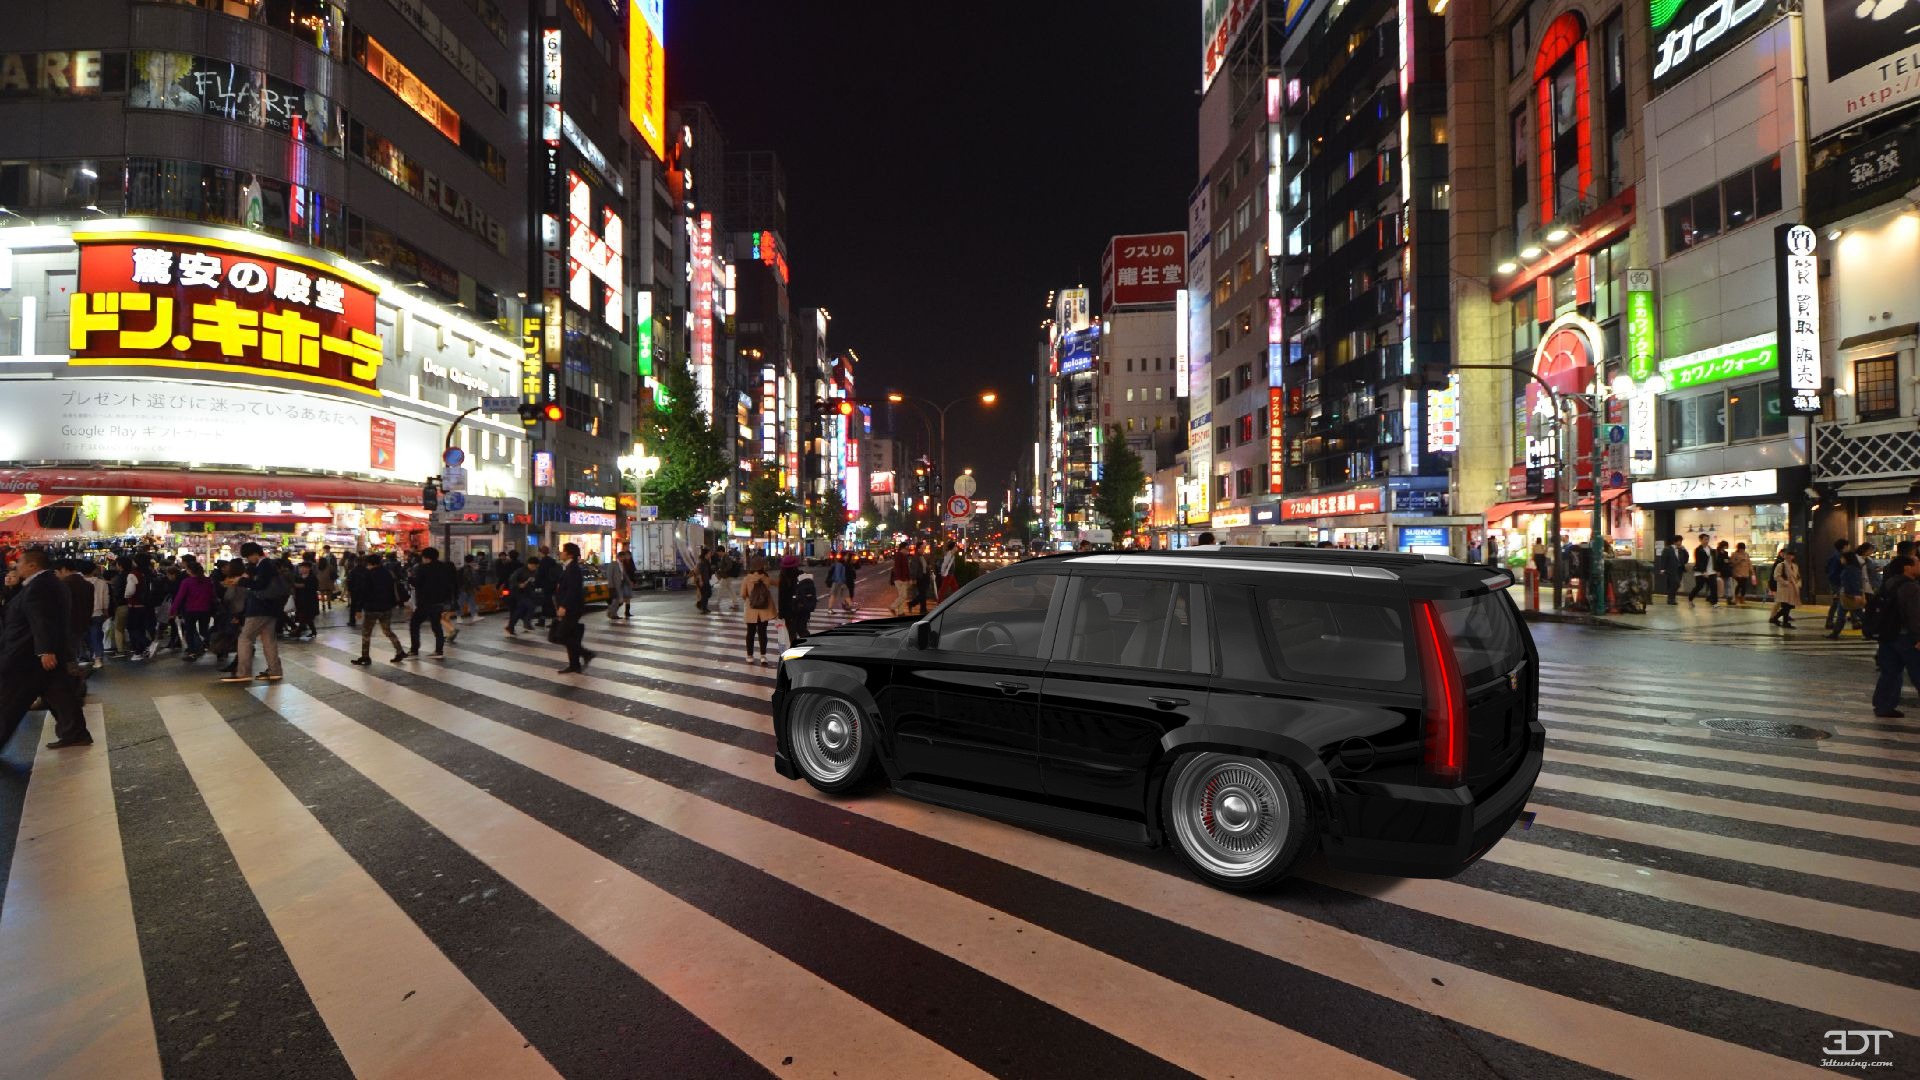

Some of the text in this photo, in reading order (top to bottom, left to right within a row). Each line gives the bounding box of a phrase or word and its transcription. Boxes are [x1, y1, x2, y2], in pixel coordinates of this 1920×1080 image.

[546, 37, 558, 95] 6年4組
[1877, 53, 1920, 81] TEL
[194, 71, 302, 118] FLARE
[423, 168, 499, 246] FLARE
[1123, 245, 1175, 259] クスリの
[131, 247, 346, 314] 驚安の殿堂
[423, 357, 489, 391] Don Quijote
[62, 390, 359, 426] プレゼント選びに迷っているあなたへ
[61, 424, 105, 439] Google
[110, 424, 136, 439] Play
[0, 480, 39, 493] uijote
[195, 486, 294, 499] Don Quijote
